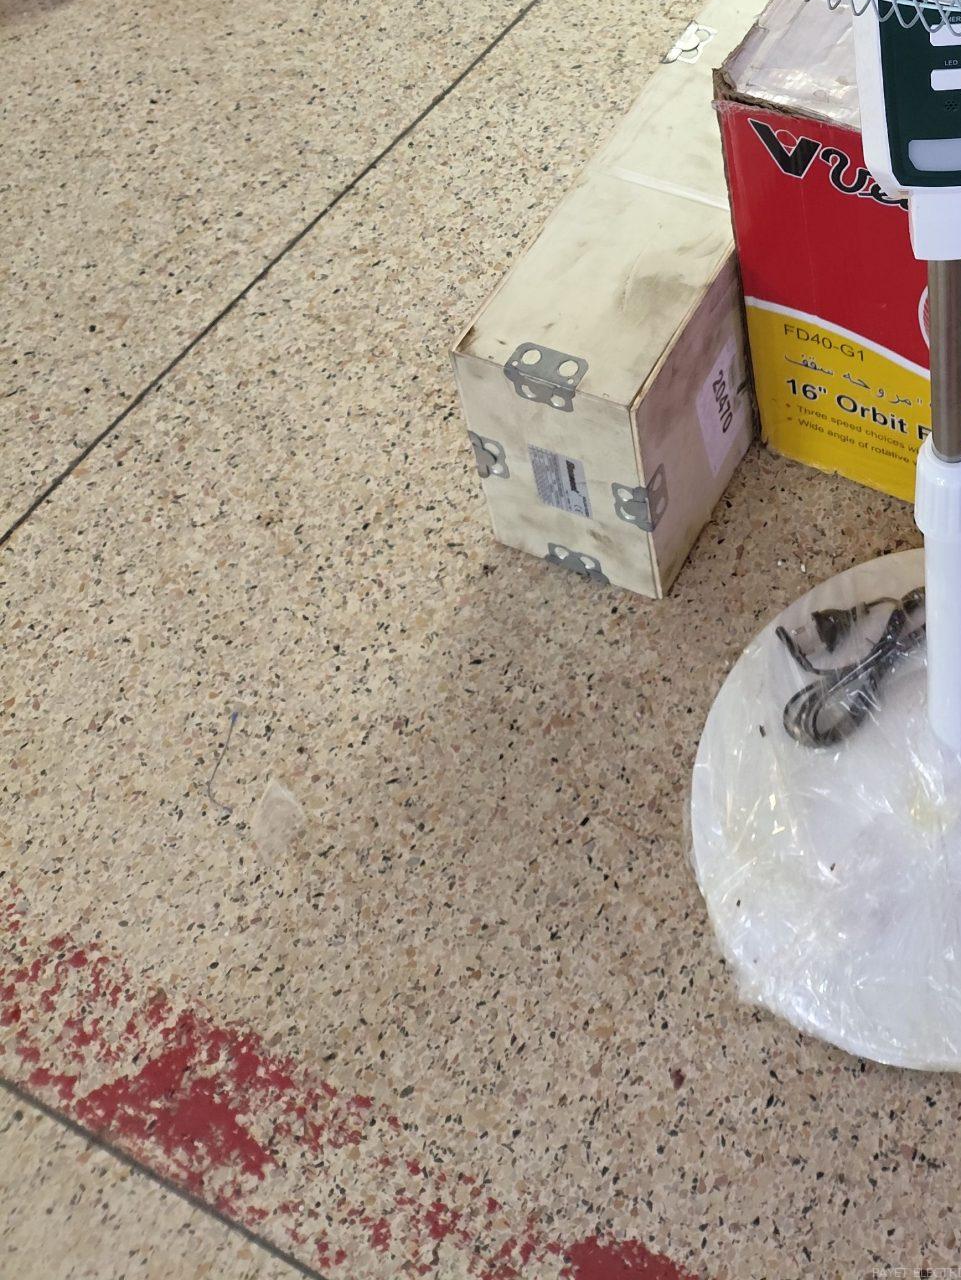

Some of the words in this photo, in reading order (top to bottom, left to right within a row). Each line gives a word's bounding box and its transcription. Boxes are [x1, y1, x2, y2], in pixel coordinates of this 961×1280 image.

[944, 58, 959, 66] LED
[783, 324, 866, 362] FD40-G1
[711, 370, 734, 434] 20470
[786, 378, 827, 401] 16"
[836, 394, 908, 434] Orbit
[797, 417, 824, 432] Wide
[827, 430, 855, 445] angle
[858, 438, 869, 449] of
[871, 446, 910, 464] rotative
[798, 405, 828, 420] Three
[831, 416, 862, 432] speed
[865, 429, 905, 449] choices
